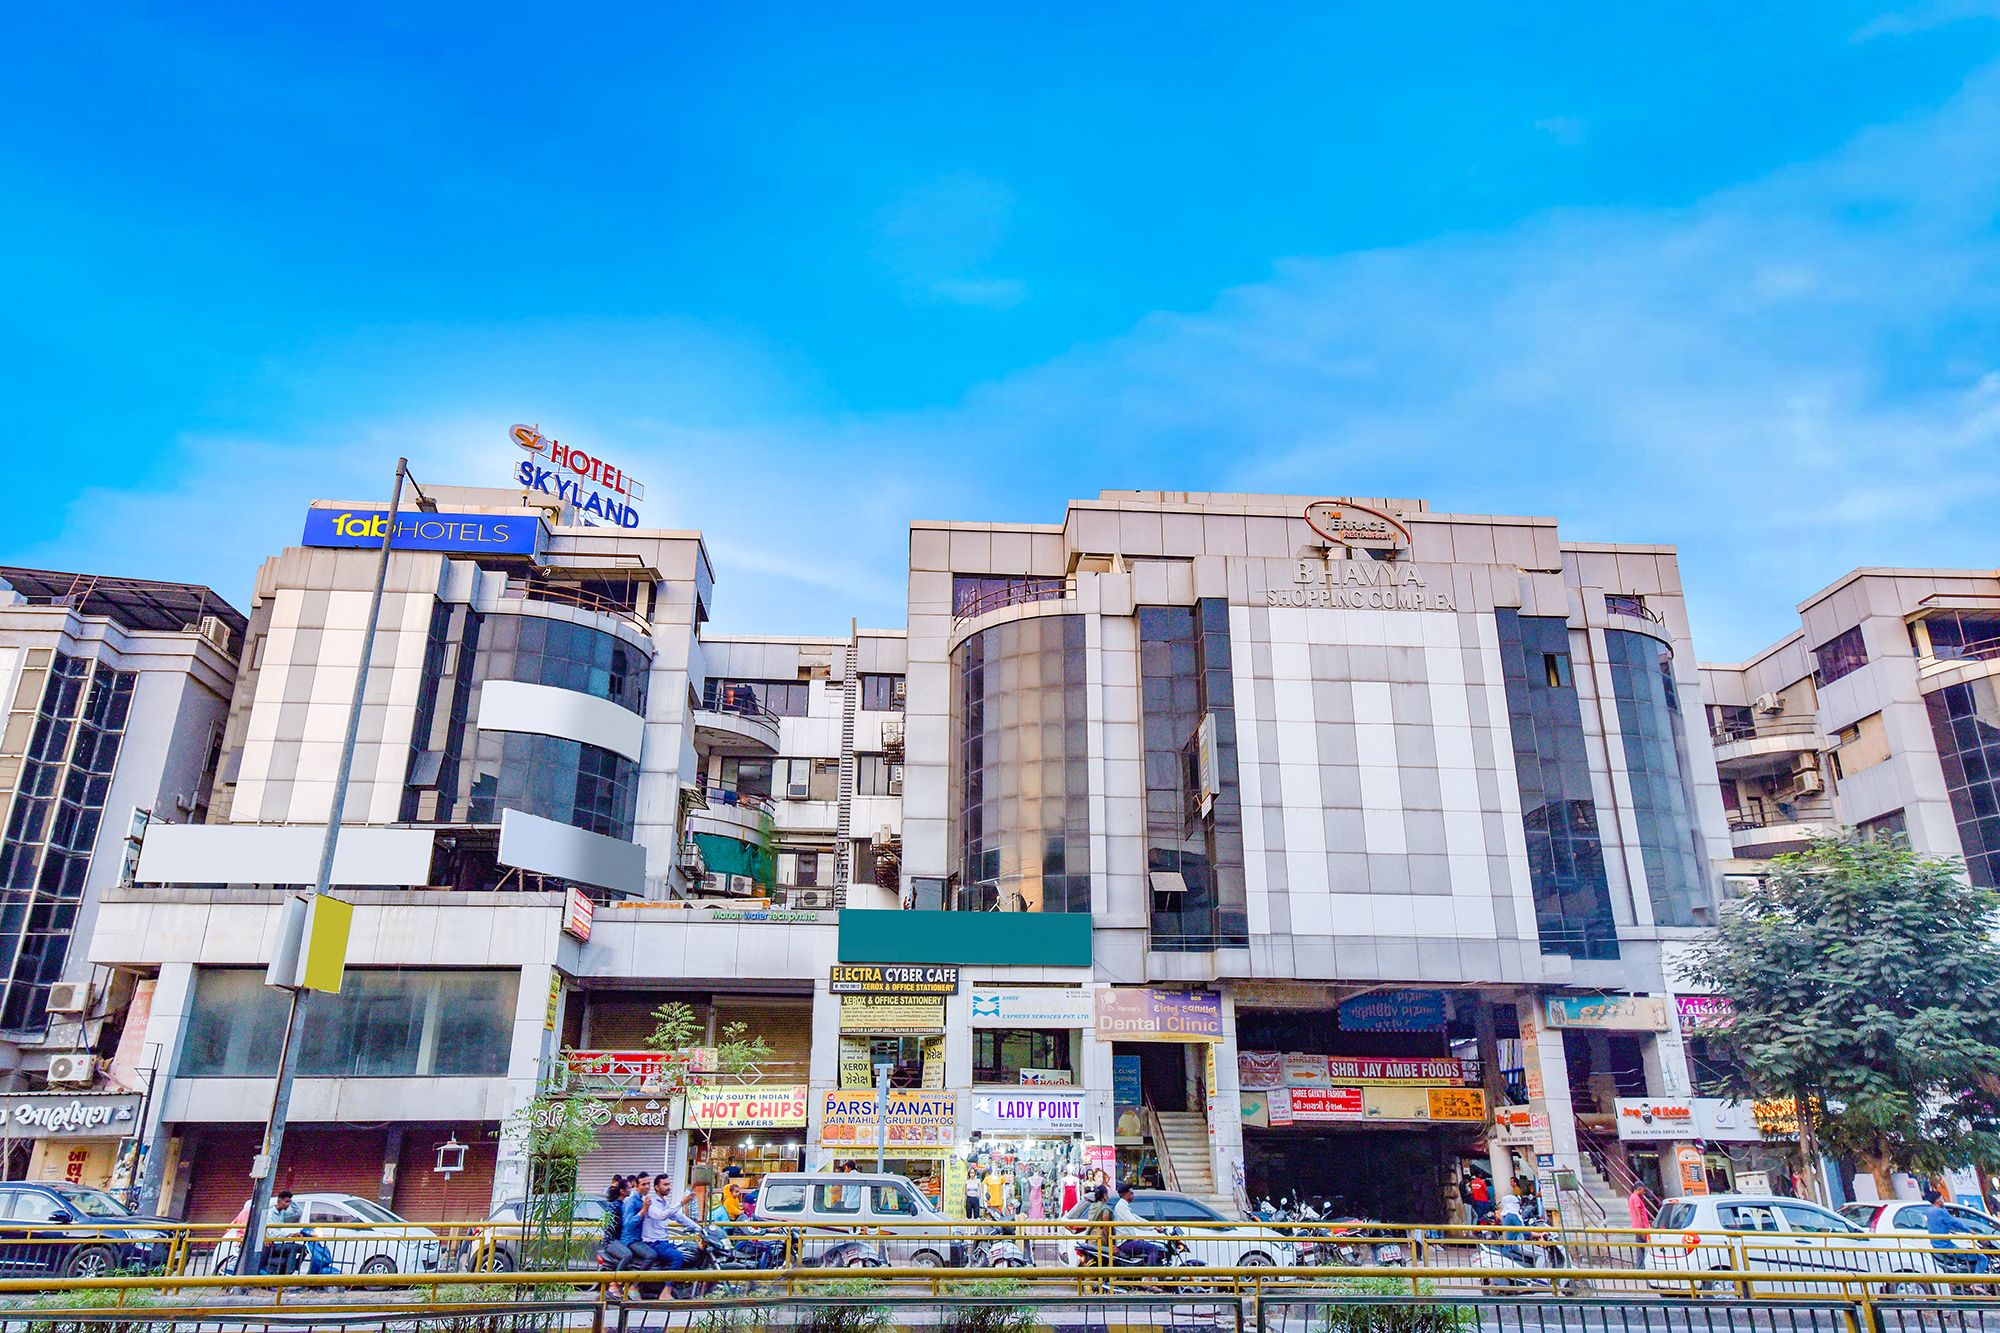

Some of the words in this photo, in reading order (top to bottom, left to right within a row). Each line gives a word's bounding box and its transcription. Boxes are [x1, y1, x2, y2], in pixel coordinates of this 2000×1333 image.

[551, 440, 625, 495] HOTEL
[519, 461, 639, 529] SKYLAND
[1294, 560, 1427, 587] BHAVYA
[1267, 590, 1365, 609] SHOPPING
[1369, 592, 1457, 611] COMPLEX
[832, 967, 882, 981] ELECTRA
[885, 968, 923, 983] CYBER
[926, 969, 956, 983] CAFE
[862, 983, 884, 991] XEROX
[885, 983, 891, 991] &
[892, 983, 915, 991] OFFICE
[915, 983, 955, 992] STATIONERY
[843, 995, 866, 1005] XEROX
[867, 996, 874, 1005] &
[874, 995, 899, 1005] OFFICE
[899, 995, 942, 1005] STATIONERY
[1100, 1016, 1160, 1031] Dental
[1167, 1017, 1218, 1032] Clinic
[843, 1063, 868, 1071] XEROX
[1332, 1062, 1359, 1077] SHRI
[1362, 1063, 1382, 1077] JAY
[1386, 1063, 1418, 1077] AMBE
[1422, 1063, 1460, 1077] FOODS
[1292, 1090, 1308, 1098] SHREE
[1327, 1090, 1346, 1098] FASHION
[702, 1102, 740, 1118] HOT
[746, 1102, 804, 1118] CHIPS
[998, 1101, 1034, 1118] LADY
[1038, 1101, 1080, 1118] POINT
[824, 1117, 845, 1125] JAIN
[885, 1117, 911, 1125] GRUH
[914, 1117, 954, 1125] UDHYOG
